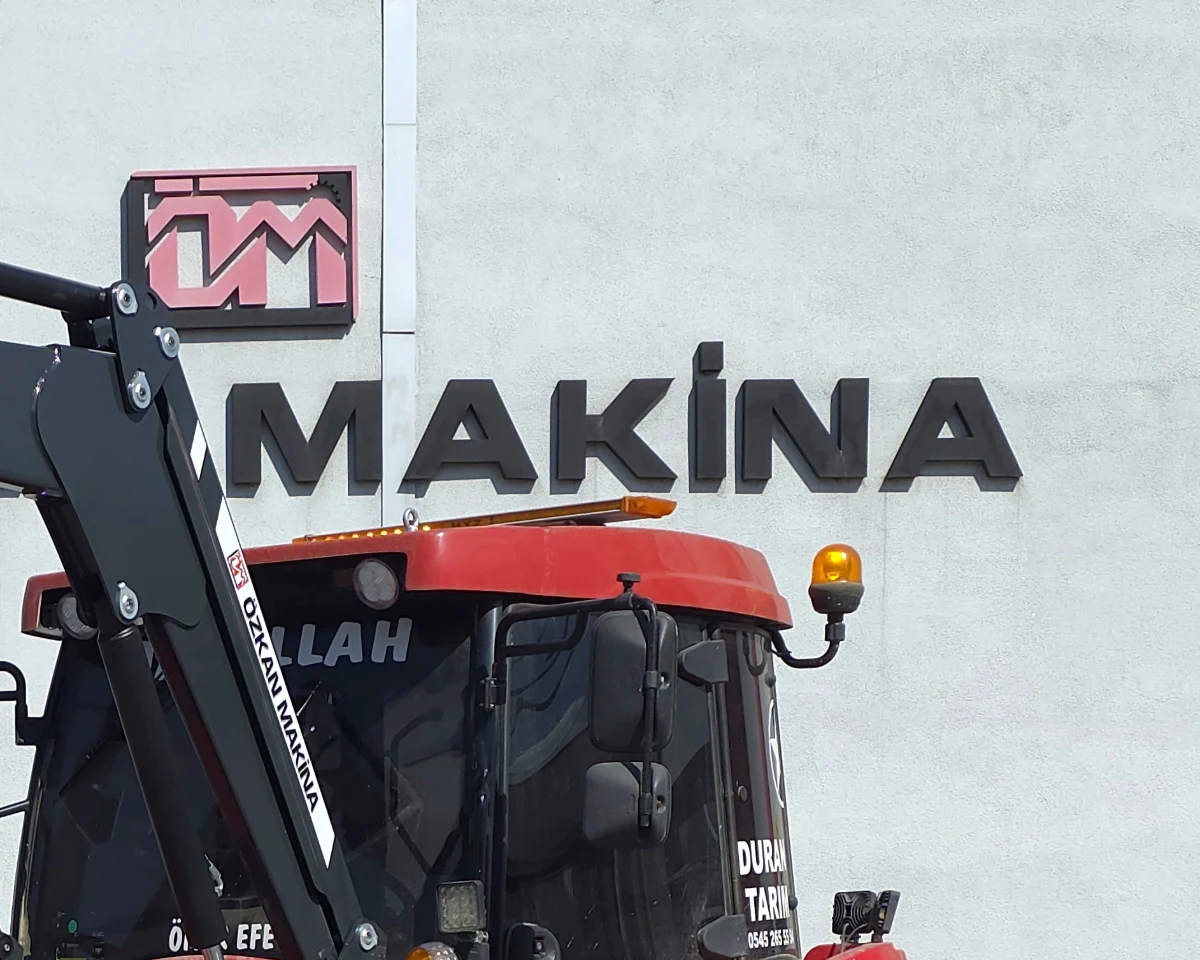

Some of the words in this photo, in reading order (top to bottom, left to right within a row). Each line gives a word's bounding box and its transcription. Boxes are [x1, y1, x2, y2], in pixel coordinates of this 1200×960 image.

[226, 341, 1023, 486] MAKİNA
[271, 617, 414, 667] LLAH
[243, 596, 283, 696] ÖZKAN
[277, 699, 319, 813] MAKİNA
[744, 885, 791, 922] TARIM
[236, 923, 275, 951] EFE
[747, 931, 769, 949] 0545
